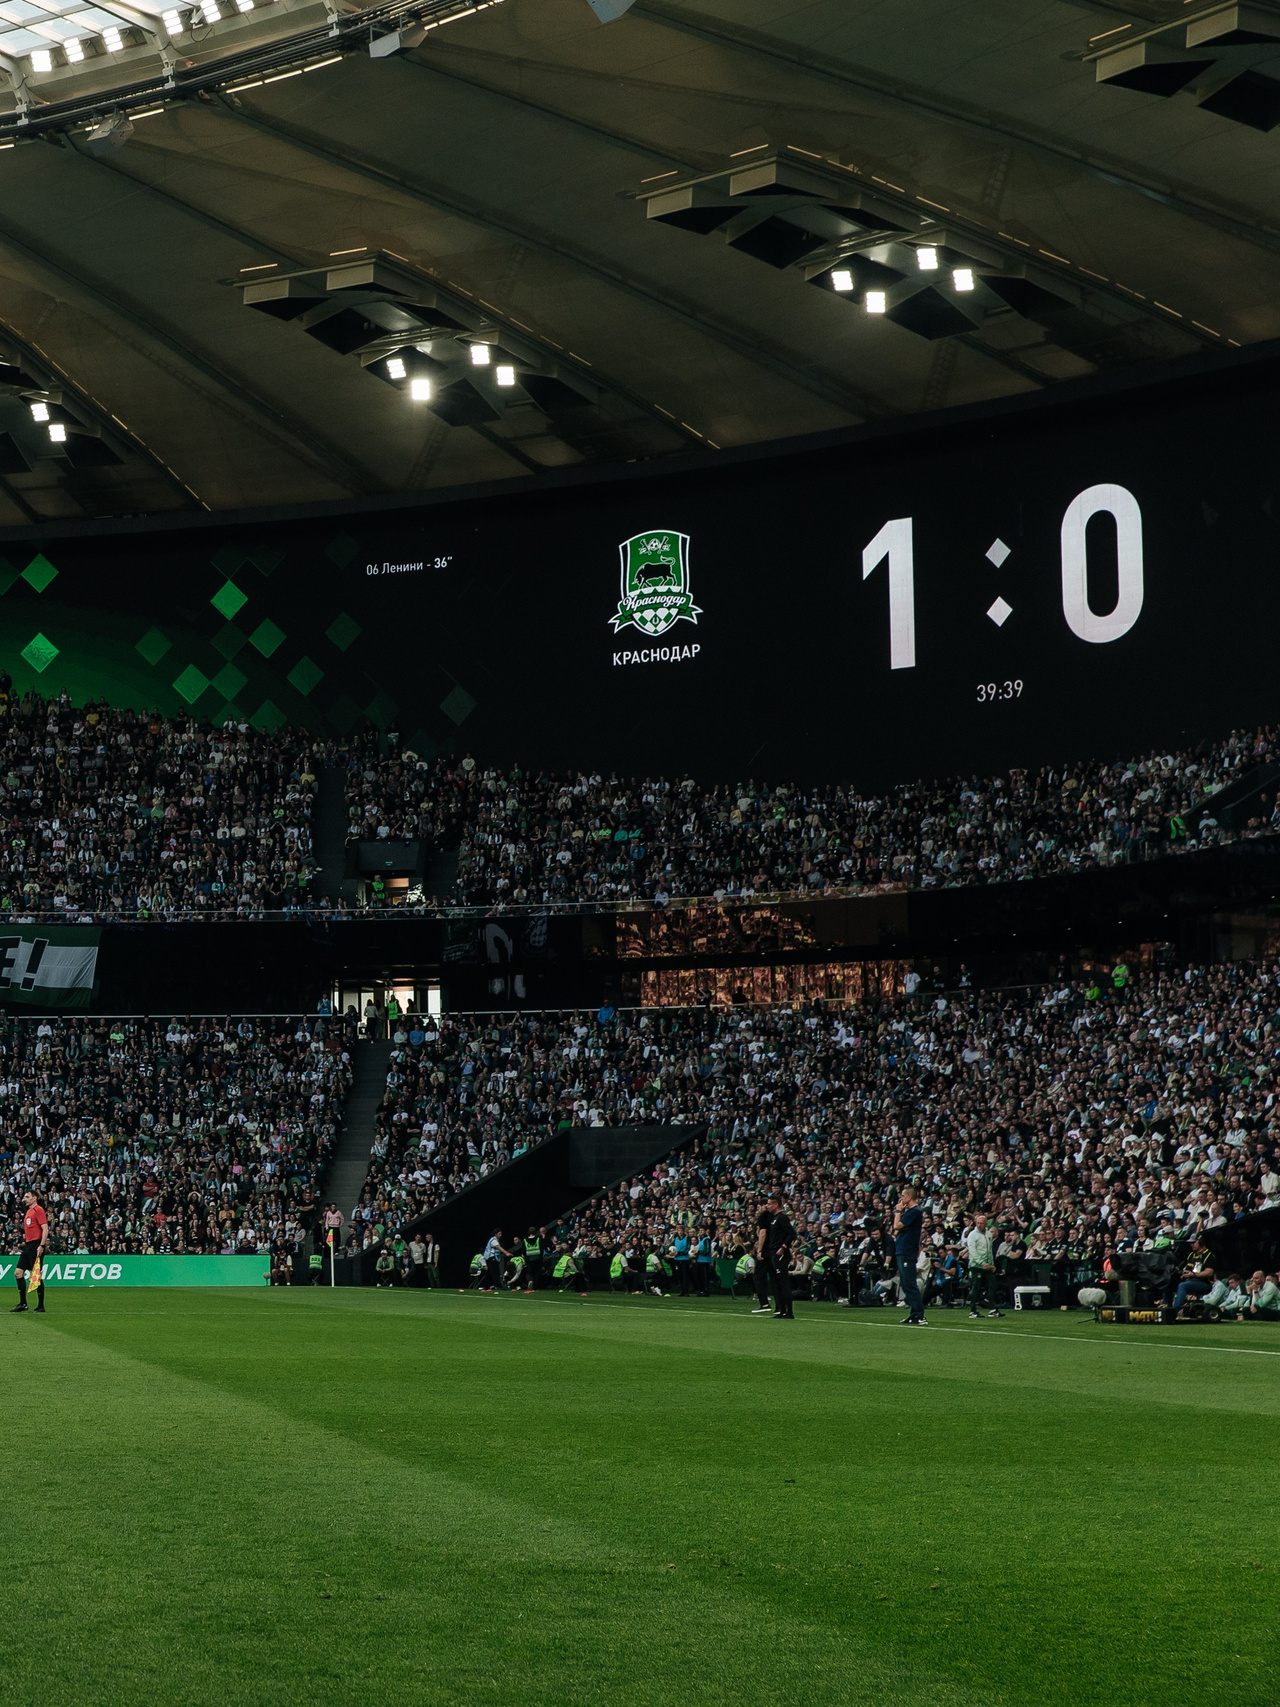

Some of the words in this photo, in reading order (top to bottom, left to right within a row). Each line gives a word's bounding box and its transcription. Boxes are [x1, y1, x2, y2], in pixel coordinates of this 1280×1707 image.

[366, 563, 379, 576] 06
[381, 562, 423, 575] Ленини
[862, 516, 916, 670] 1
[1061, 483, 1144, 644] 0
[622, 594, 687, 611] Краснодар
[613, 644, 701, 666] КРАСНОДАР
[976, 679, 1024, 703] 39:39
